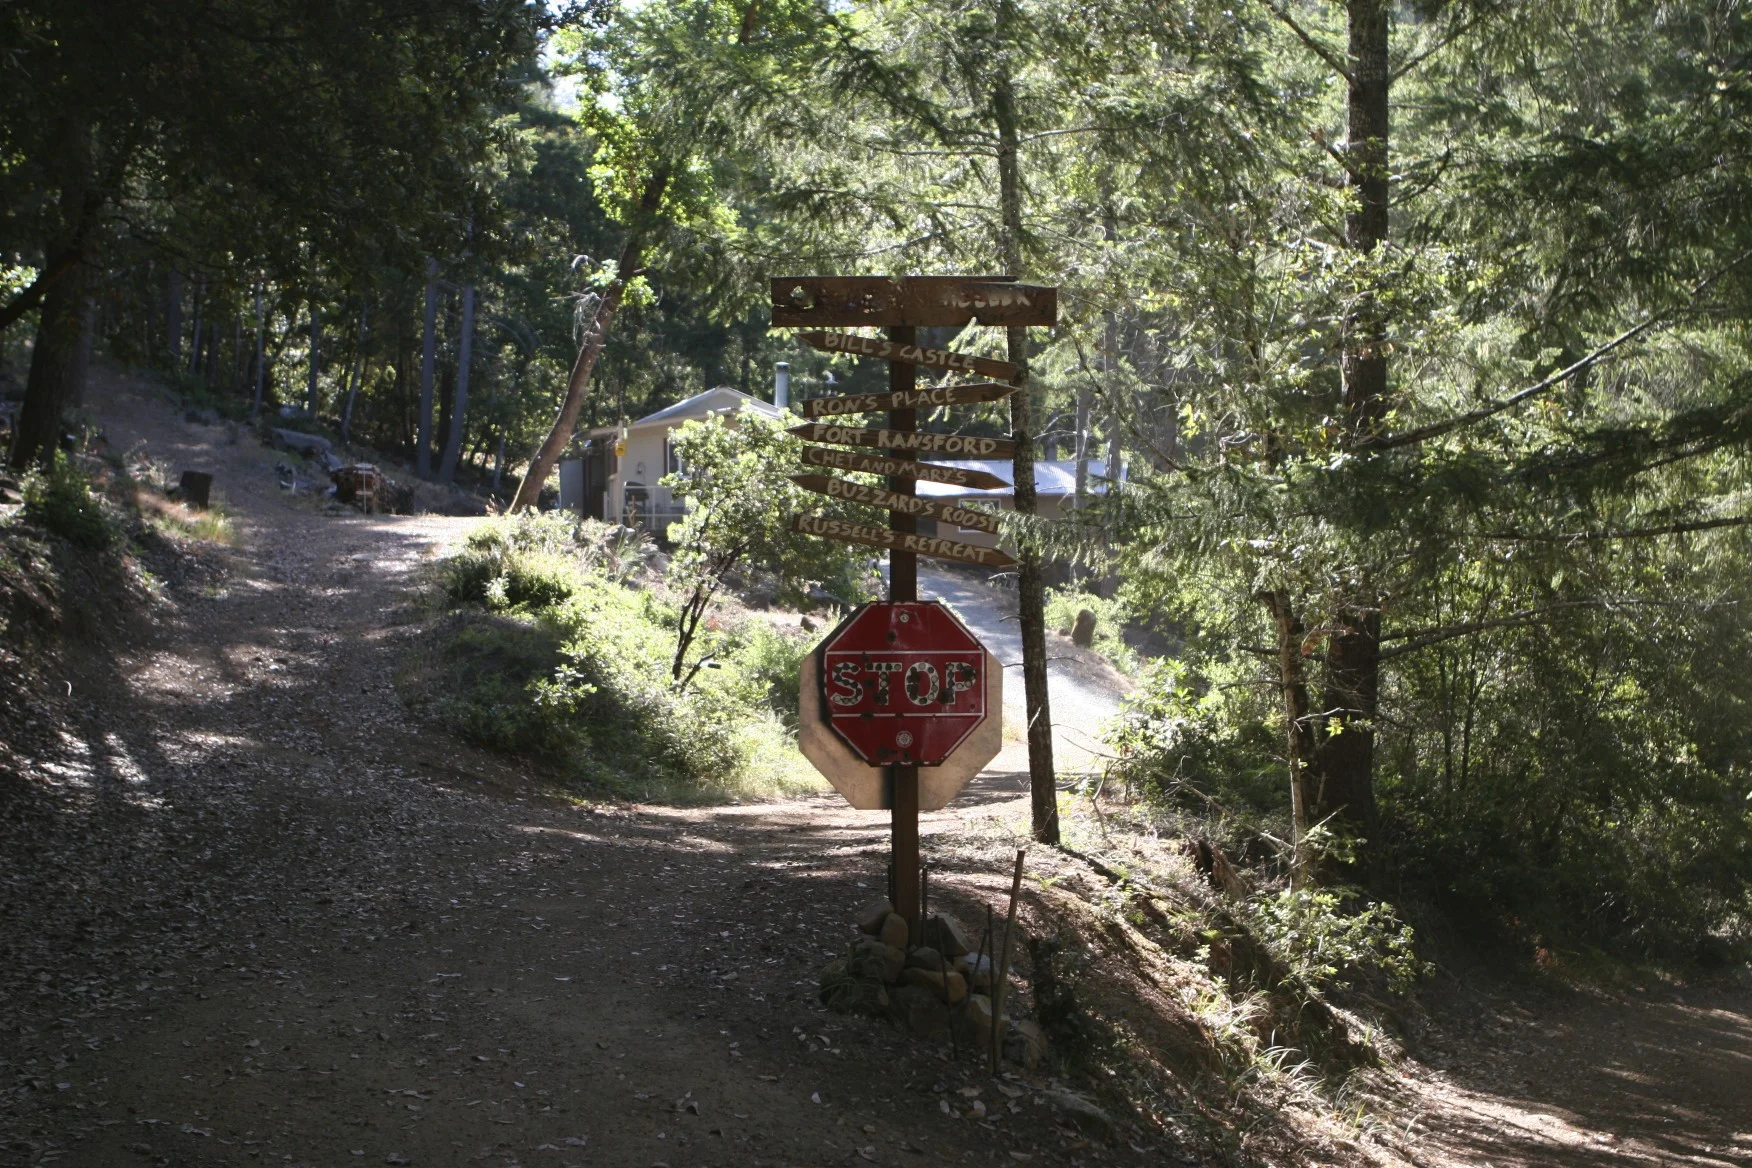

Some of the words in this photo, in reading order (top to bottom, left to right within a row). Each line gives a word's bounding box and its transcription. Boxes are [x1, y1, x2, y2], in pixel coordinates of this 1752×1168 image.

[825, 331, 893, 354] BILL'S
[900, 346, 976, 369] CASTLE
[812, 395, 877, 416] RON'S
[892, 386, 956, 408] PLACE
[813, 424, 868, 445] FORT
[878, 430, 997, 454] RANSFORD
[808, 448, 857, 465] CHET
[860, 458, 894, 475] AND
[899, 462, 967, 484] MARY'S
[827, 479, 934, 516] BUZZARD'S
[942, 506, 999, 532] ROOST
[799, 515, 895, 543] RUSSELL'S
[904, 535, 993, 563] RETREAT
[831, 661, 977, 706] STOP
